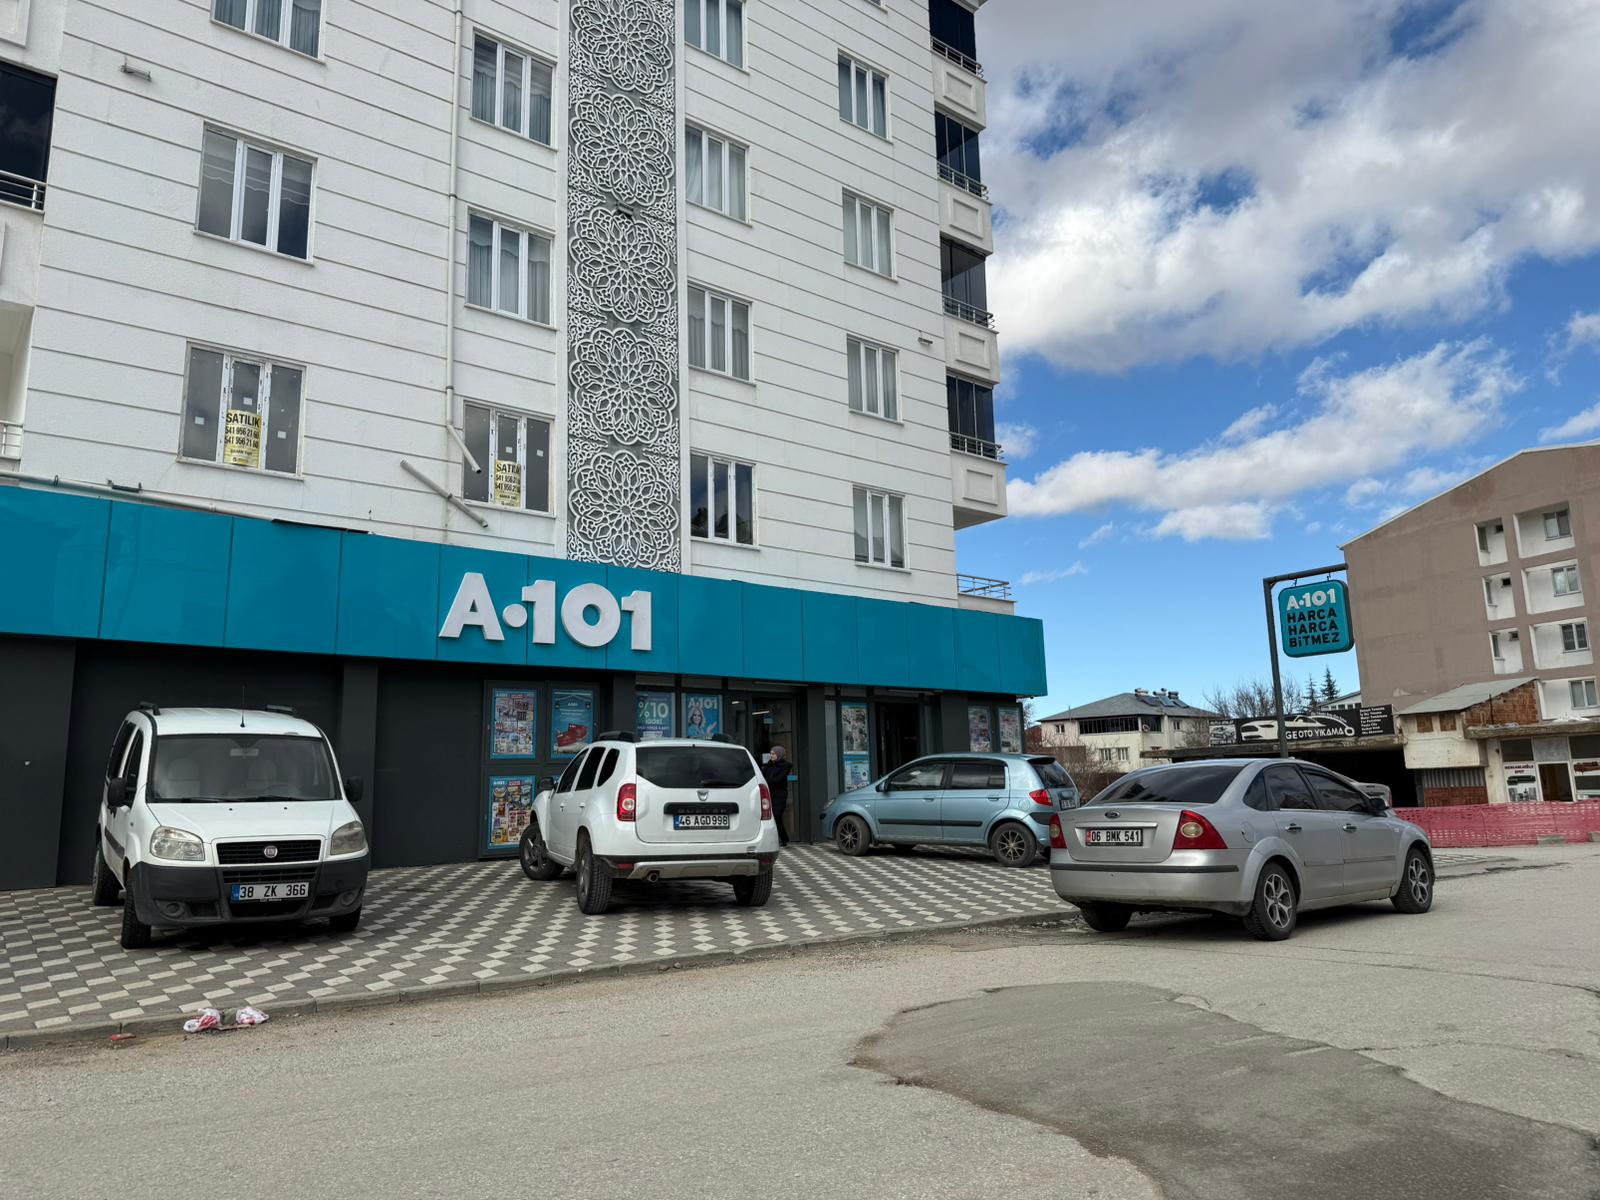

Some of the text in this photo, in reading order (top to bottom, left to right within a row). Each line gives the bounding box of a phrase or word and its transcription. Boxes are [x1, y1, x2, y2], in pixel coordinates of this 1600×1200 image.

[226, 413, 260, 427] SATILIK
[1286, 607, 1337, 624] HARCA
[1288, 619, 1339, 636] HARCA
[638, 701, 669, 719] %10
[1298, 730, 1314, 738] OTO
[1314, 727, 1345, 737] YIKAMA
[680, 815, 691, 825] 46
[1091, 830, 1140, 842] 06 BMK 541
[240, 884, 306, 899] 38 ZK 366
